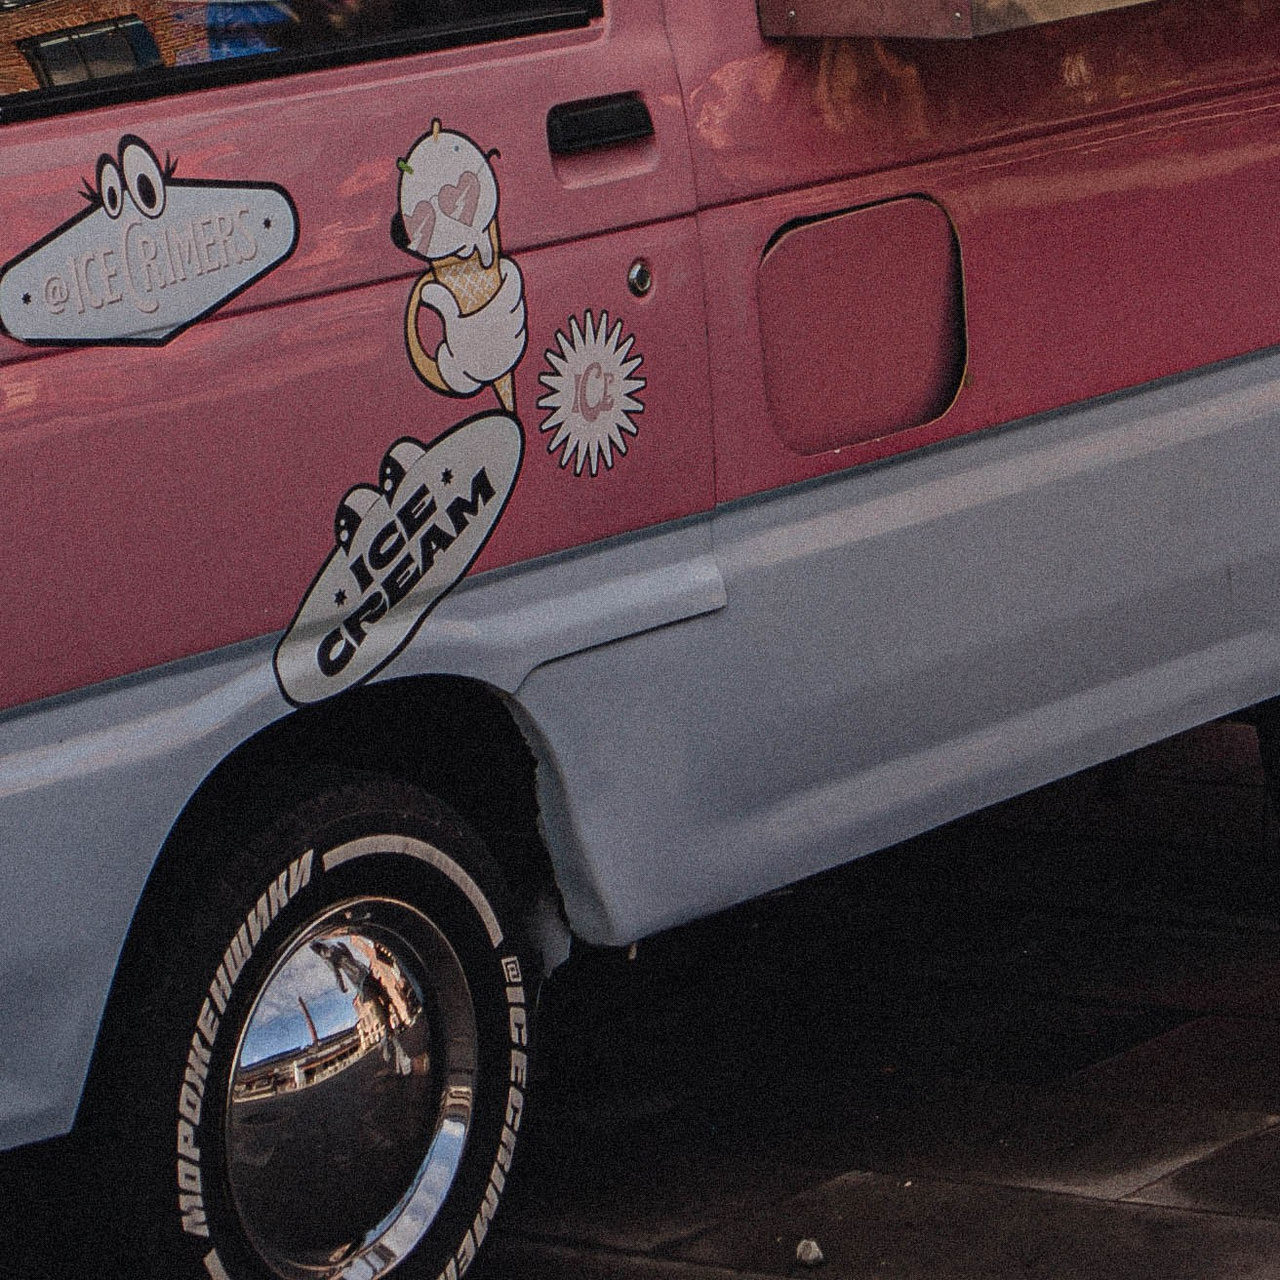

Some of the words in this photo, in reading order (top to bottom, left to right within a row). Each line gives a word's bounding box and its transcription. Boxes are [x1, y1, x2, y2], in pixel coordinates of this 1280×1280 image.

[45, 208, 258, 314] @ICECRIMERS
[570, 361, 616, 422] ICE
[315, 467, 496, 678] CREAM
[348, 483, 438, 597] ICE
[177, 848, 315, 1239] МОРОЖЕНЩИКИ
